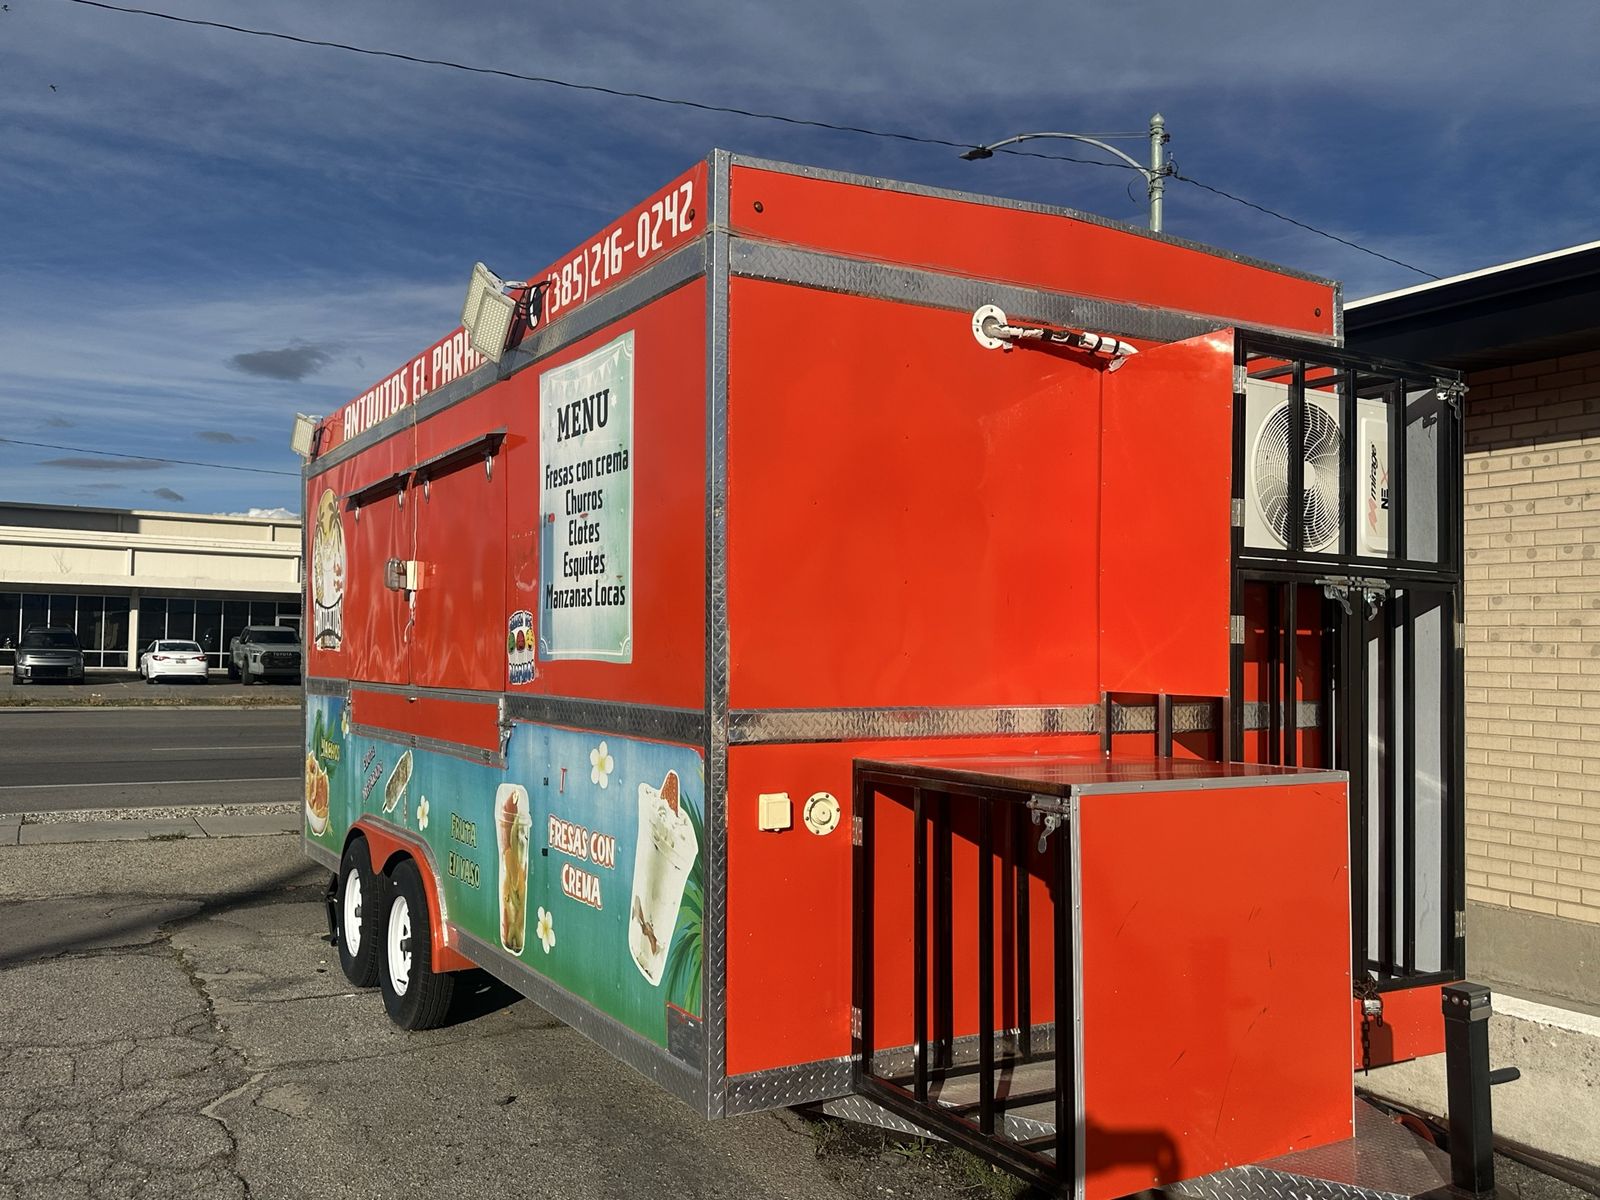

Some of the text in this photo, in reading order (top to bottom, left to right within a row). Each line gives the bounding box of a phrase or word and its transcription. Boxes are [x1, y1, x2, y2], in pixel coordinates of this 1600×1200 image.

[545, 180, 694, 323] (385)216-0242
[343, 328, 489, 441] ANTOJITOS EL PARA
[556, 388, 610, 442] MENU
[545, 449, 629, 490] Fresas con crema
[565, 488, 603, 516] Churros
[568, 519, 600, 546] Elotes
[563, 550, 606, 582] Esquites
[545, 579, 626, 610] Manzanas Locas
[450, 811, 477, 848] FRUTA
[548, 814, 615, 870] FRESAS CON
[460, 856, 480, 889] VASO
[561, 863, 603, 910] CREMA
